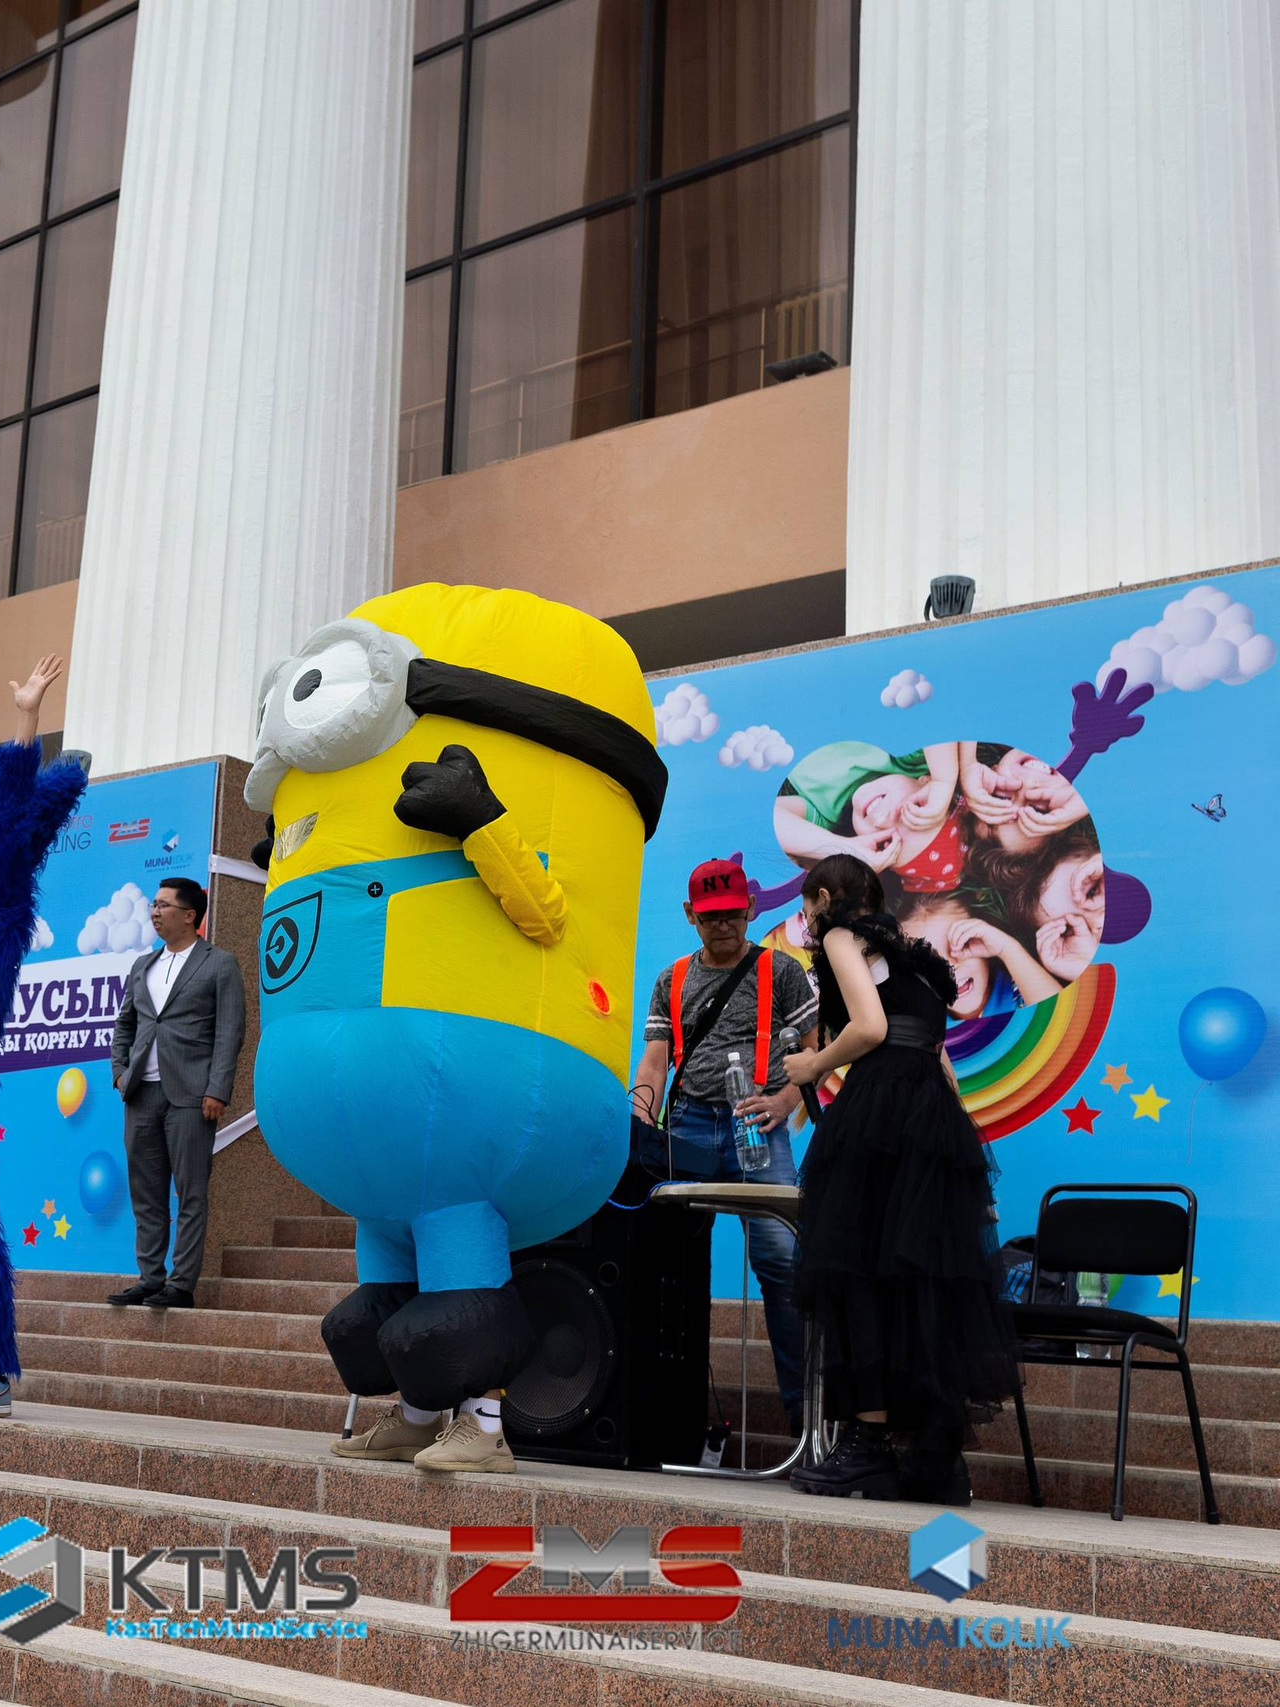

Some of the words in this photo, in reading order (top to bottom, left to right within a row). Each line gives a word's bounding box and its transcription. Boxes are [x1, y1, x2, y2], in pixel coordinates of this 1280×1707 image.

[48, 831, 91, 854] LING
[702, 874, 731, 893] NY
[6, 975, 130, 1024] УСЫМ
[24, 1029, 90, 1054] ҚОРҒАУ
